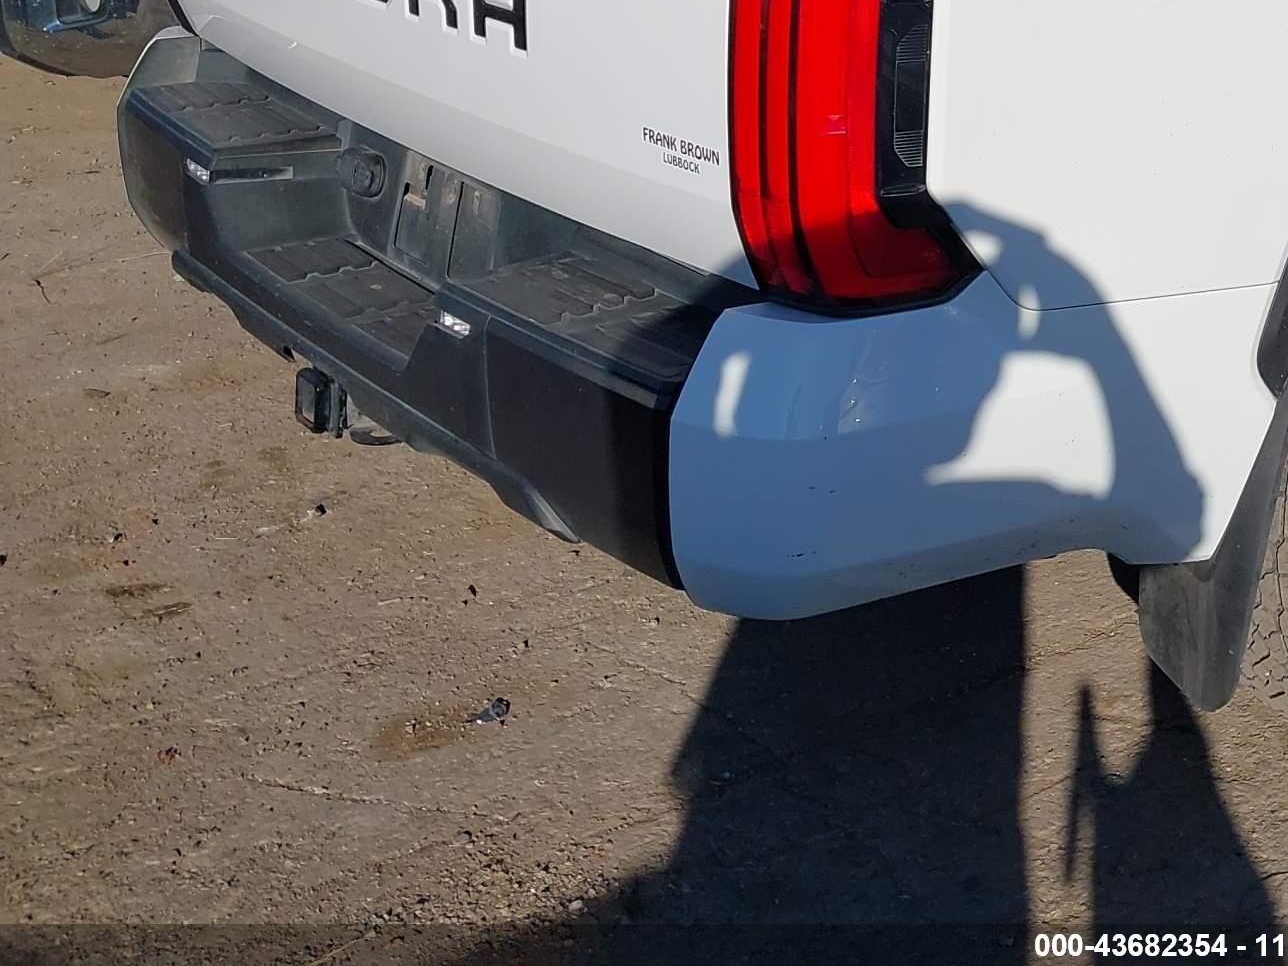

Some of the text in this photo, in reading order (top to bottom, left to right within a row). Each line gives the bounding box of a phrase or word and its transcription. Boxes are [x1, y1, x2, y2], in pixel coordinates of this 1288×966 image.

[643, 127, 720, 166] FRANK BROWN
[663, 151, 700, 174] LUBBOCK
